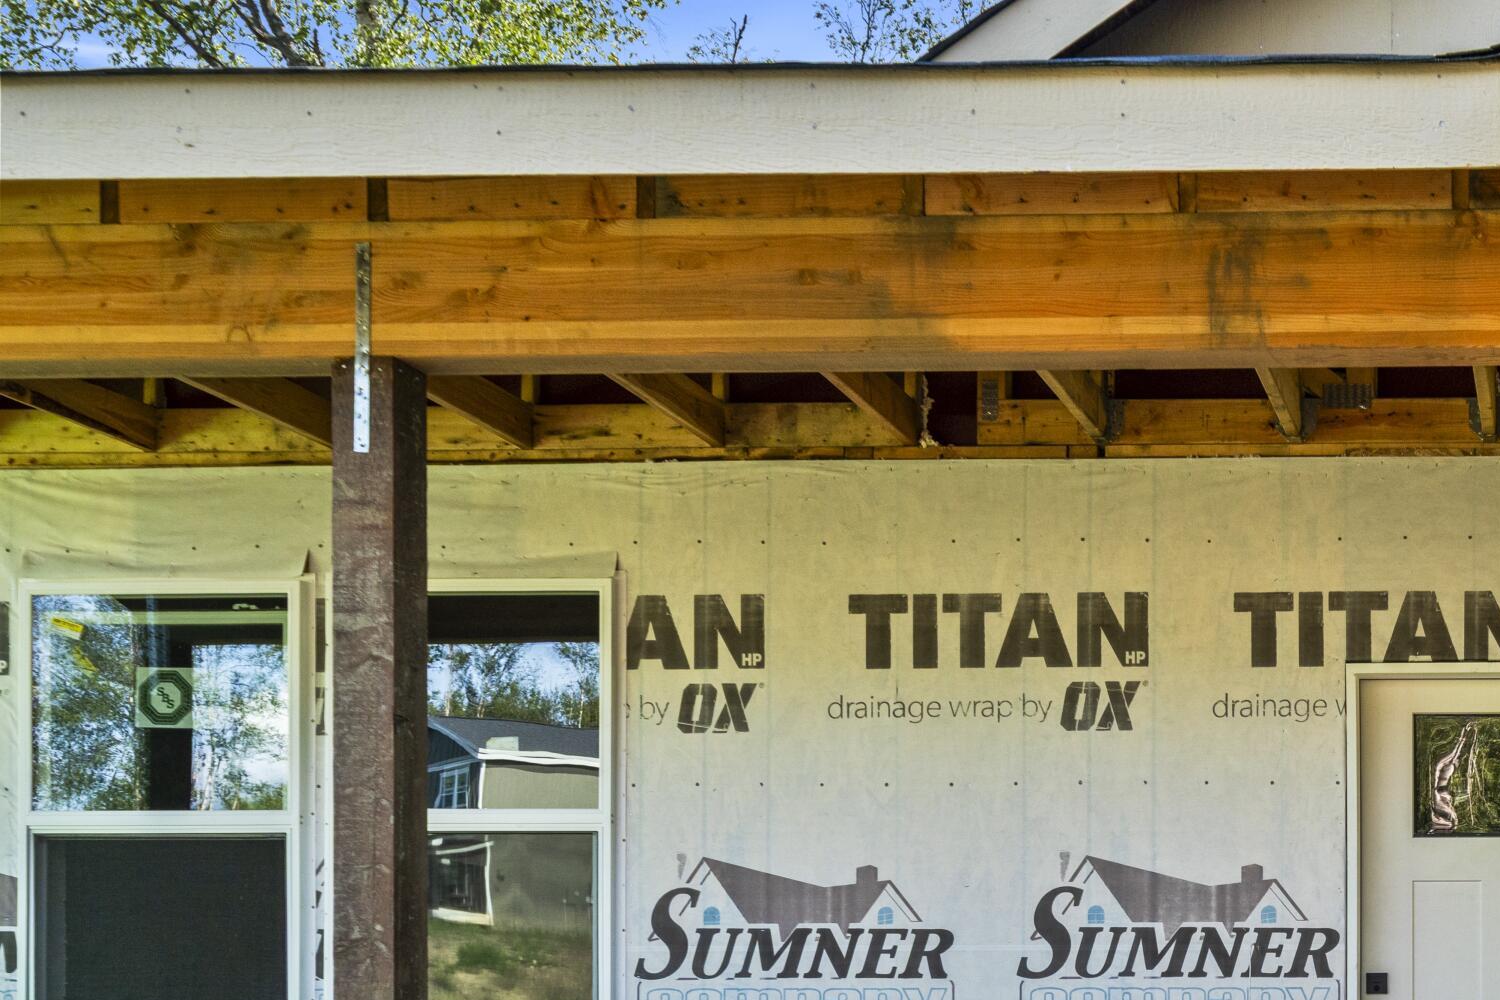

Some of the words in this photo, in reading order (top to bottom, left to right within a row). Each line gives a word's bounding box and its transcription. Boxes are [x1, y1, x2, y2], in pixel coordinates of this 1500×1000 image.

[848, 592, 1149, 669] TITAN
[741, 654, 763, 667] HP
[1124, 651, 1147, 664] HP
[639, 695, 670, 726] by
[827, 694, 941, 723] drainage
[951, 698, 1013, 723] wrap
[1023, 693, 1053, 720] by
[1212, 693, 1328, 723] drainage
